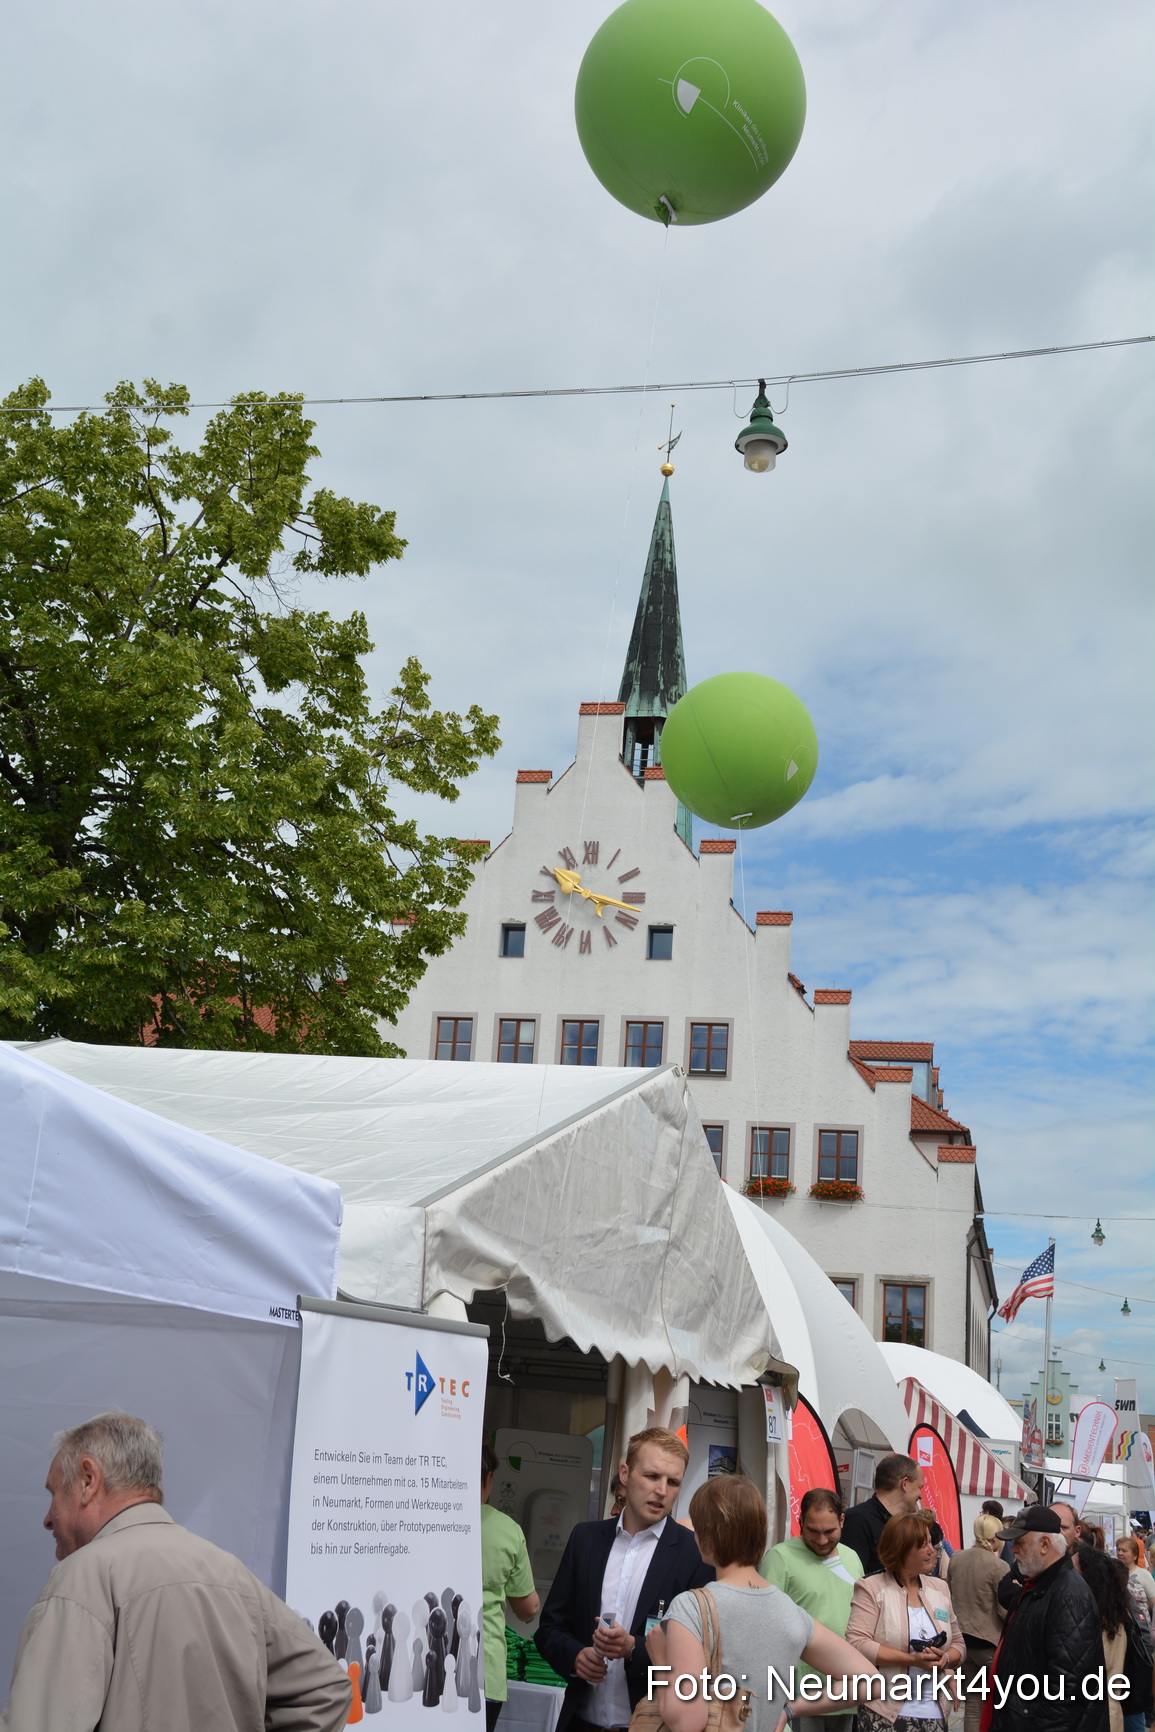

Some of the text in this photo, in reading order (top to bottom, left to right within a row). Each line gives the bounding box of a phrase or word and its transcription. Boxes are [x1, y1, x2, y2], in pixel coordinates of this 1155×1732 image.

[732, 99, 753, 126] Kliniken
[439, 1376, 471, 1398] TEC
[1114, 1399, 1136, 1411] swn
[768, 1415, 777, 1434] 87
[1083, 1410, 1103, 1465] MEDIENTECHNIK
[314, 1448, 448, 1468] Entwickeln Sie im Team der TR TEC,
[313, 1472, 468, 1490] einem Unternehmen mit ca. 15 Mitarbeitern
[312, 1495, 464, 1513] in Neumarkt, Formen und Werkzeuge von
[311, 1519, 471, 1535] der Konstruktion, über Prototypenwerkzeuge
[310, 1542, 411, 1557] bis hin zur Serienfreigabe.
